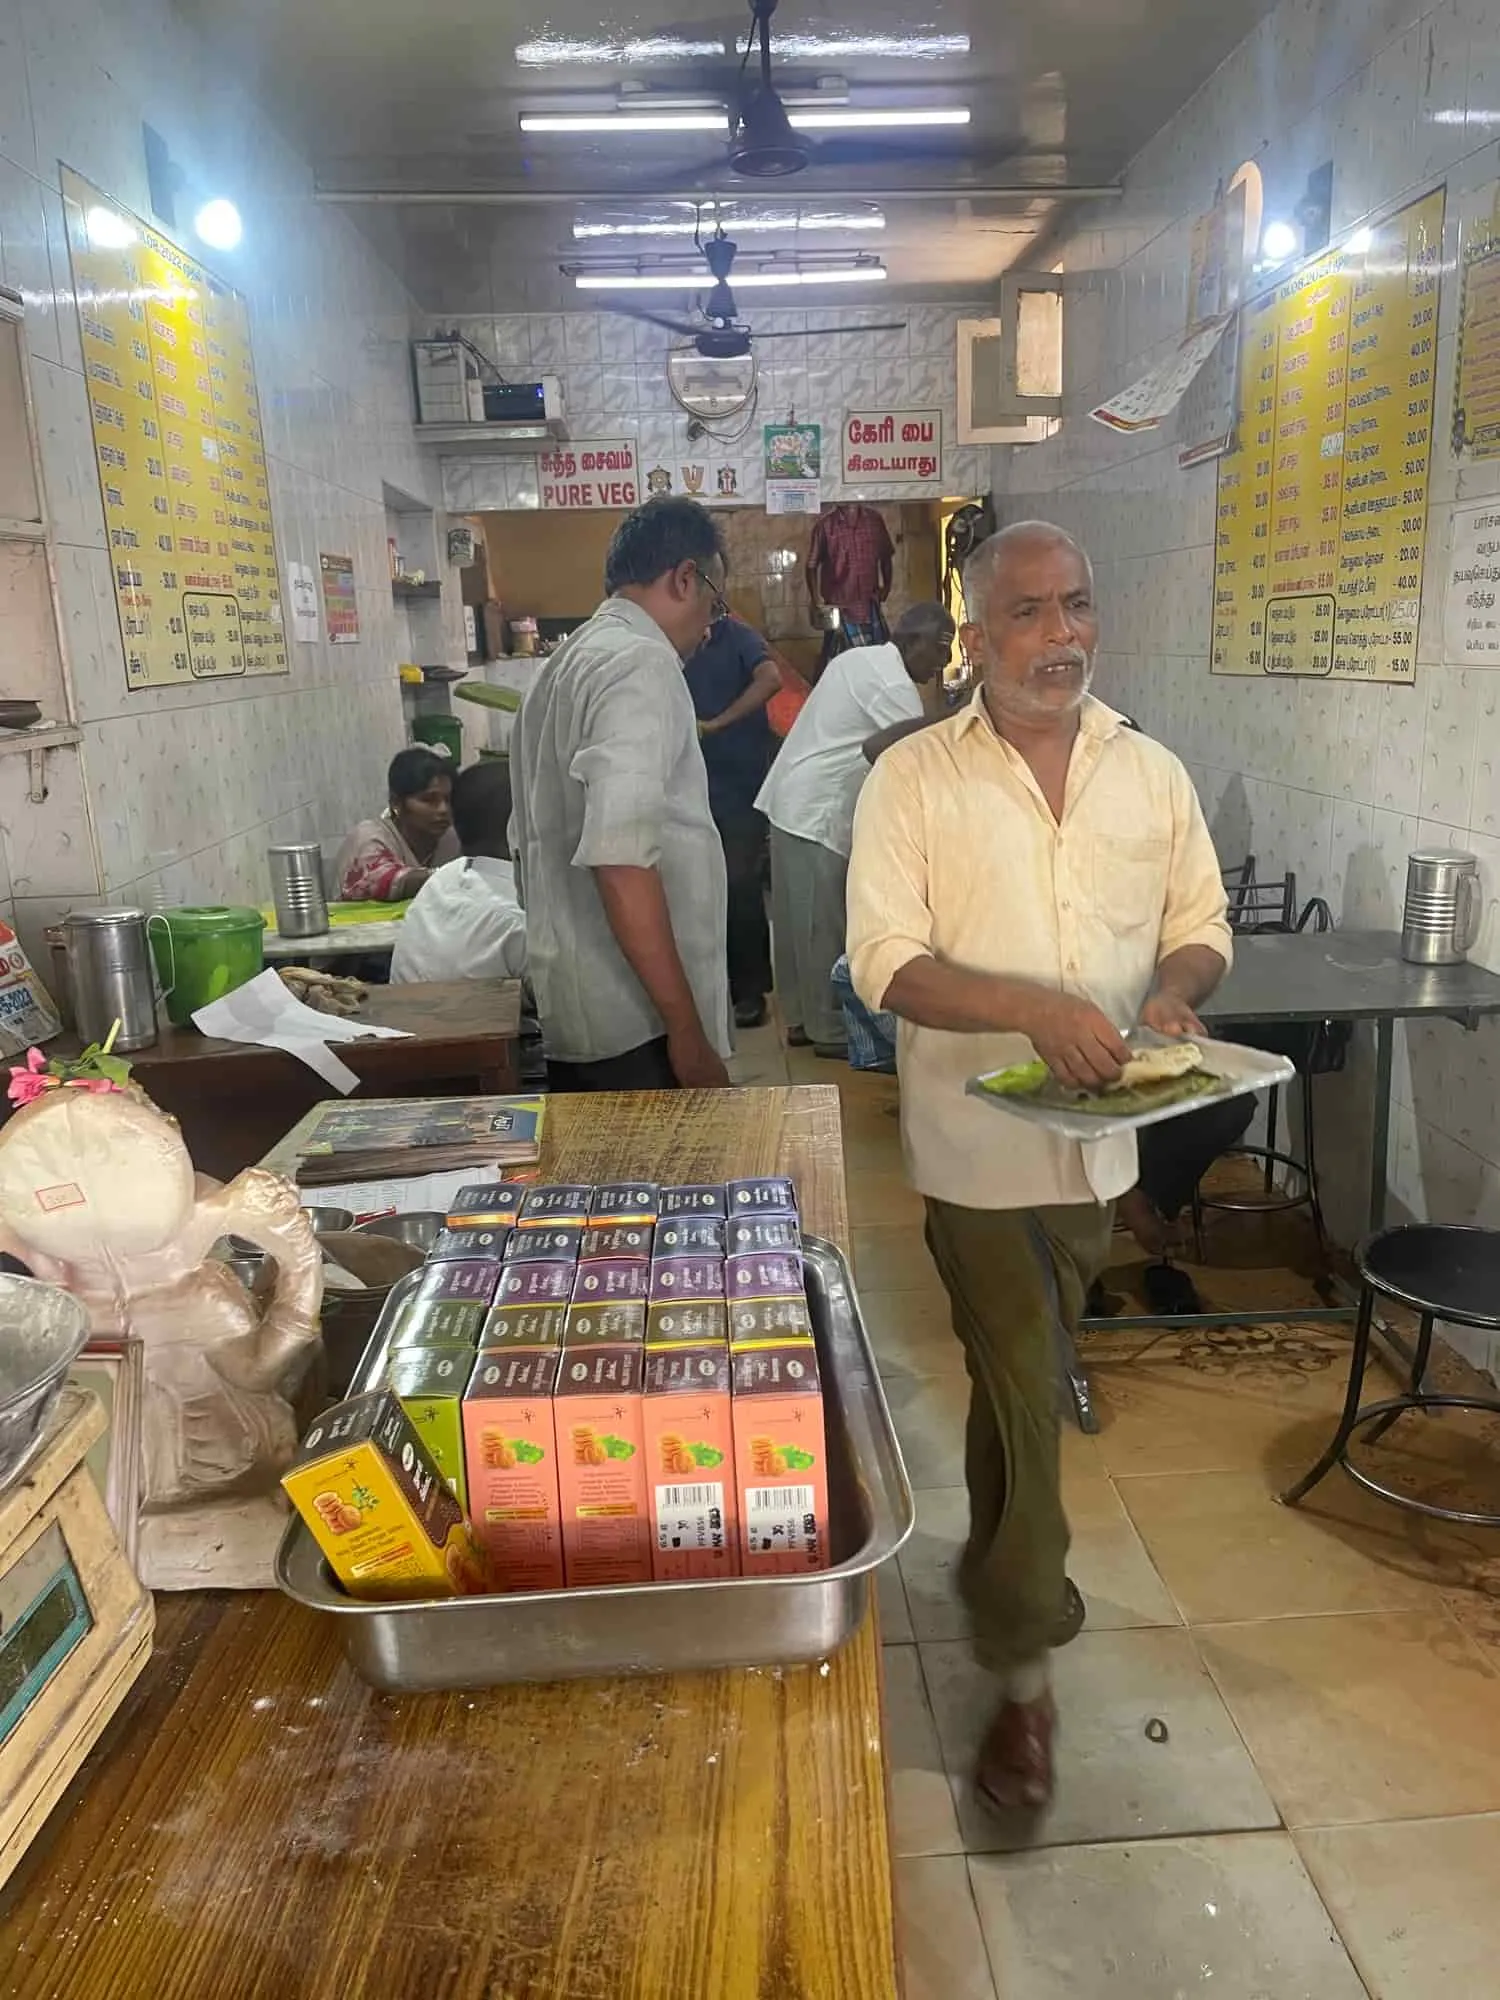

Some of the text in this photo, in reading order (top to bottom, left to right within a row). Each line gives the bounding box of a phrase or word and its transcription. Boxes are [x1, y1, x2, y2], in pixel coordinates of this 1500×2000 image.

[1408, 399, 1429, 416] 50.00
[848, 416, 934, 445] கேரி பை
[581, 443, 633, 471] சைவம்
[847, 454, 937, 477] கிடையாது
[1405, 458, 1425, 475] 50.00
[543, 482, 636, 507] PURE VEG
[1403, 487, 1424, 504] 50.00
[1402, 517, 1422, 533] 30.00
[1400, 546, 1420, 561] 20.00
[1398, 575, 1418, 588] 40.00
[1392, 631, 1413, 645] 55.00
[1391, 659, 1410, 672] 15.00
